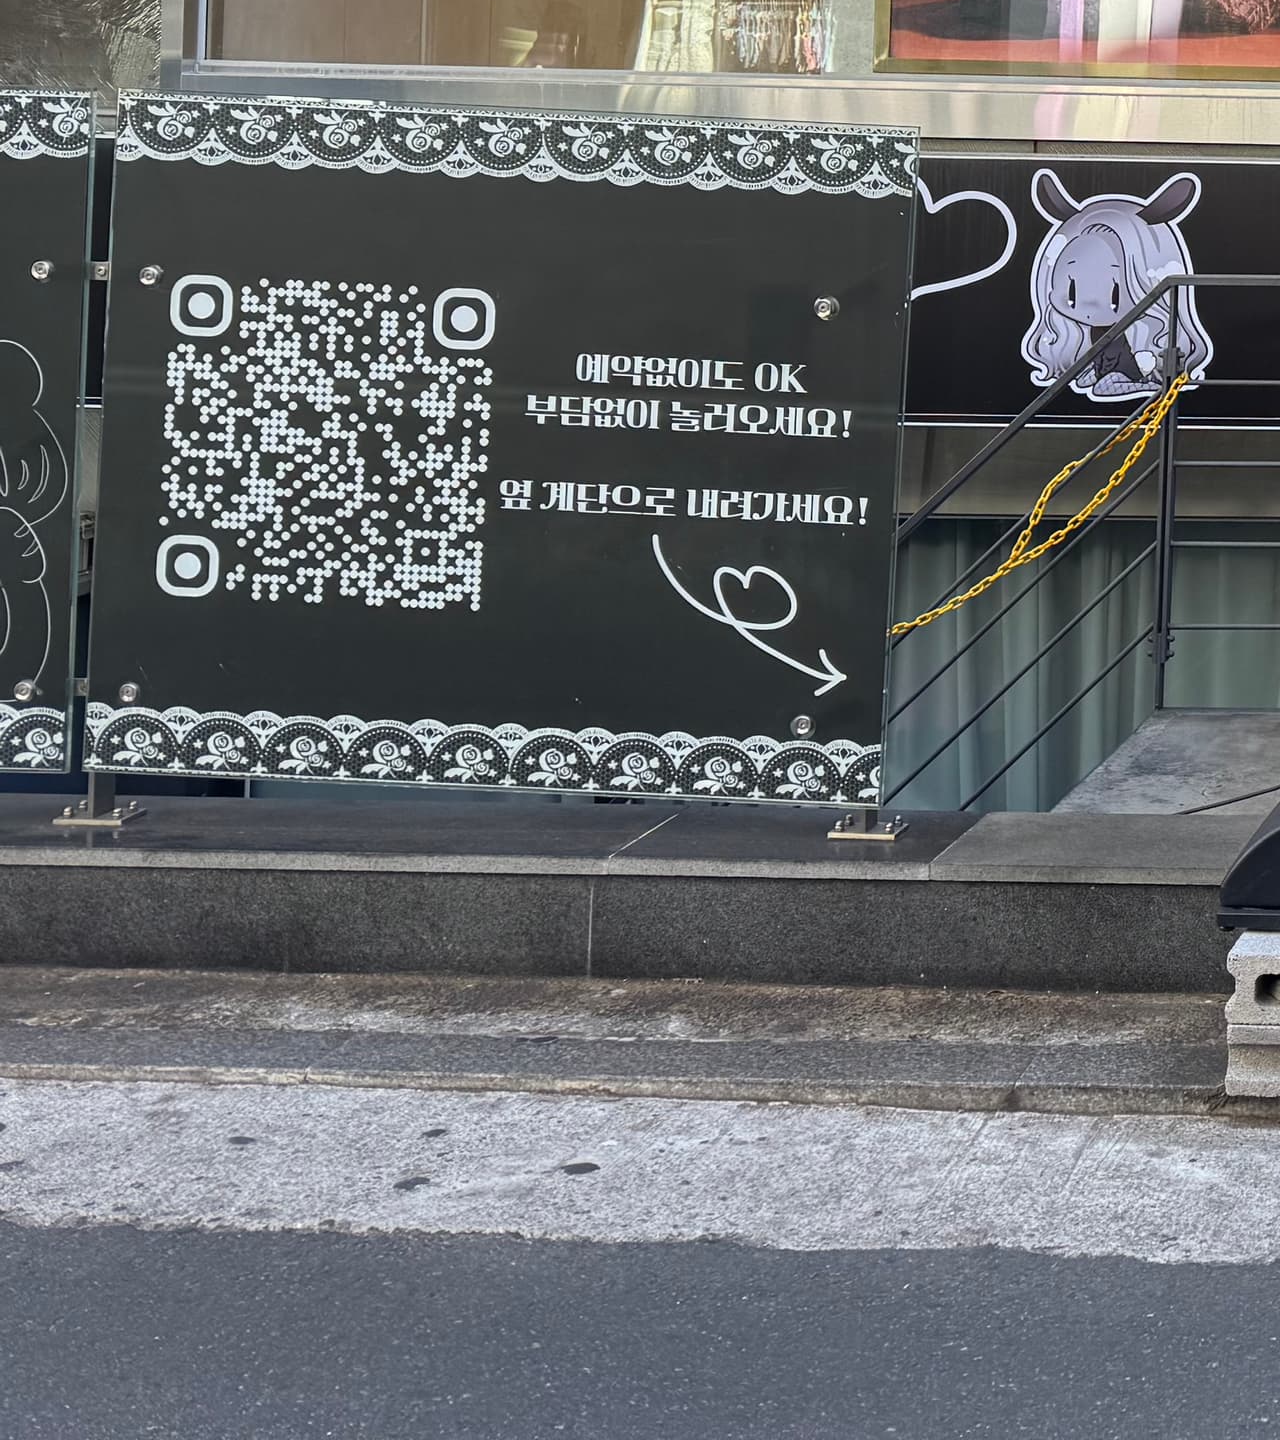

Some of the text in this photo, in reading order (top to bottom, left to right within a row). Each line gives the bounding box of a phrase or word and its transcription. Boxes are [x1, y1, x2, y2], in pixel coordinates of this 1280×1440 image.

[575, 353, 808, 394] 예약없이도 OK
[524, 393, 853, 439] 부담없이 놀러오세요!
[499, 478, 869, 526] 옆 계단으로 내려가세요!
